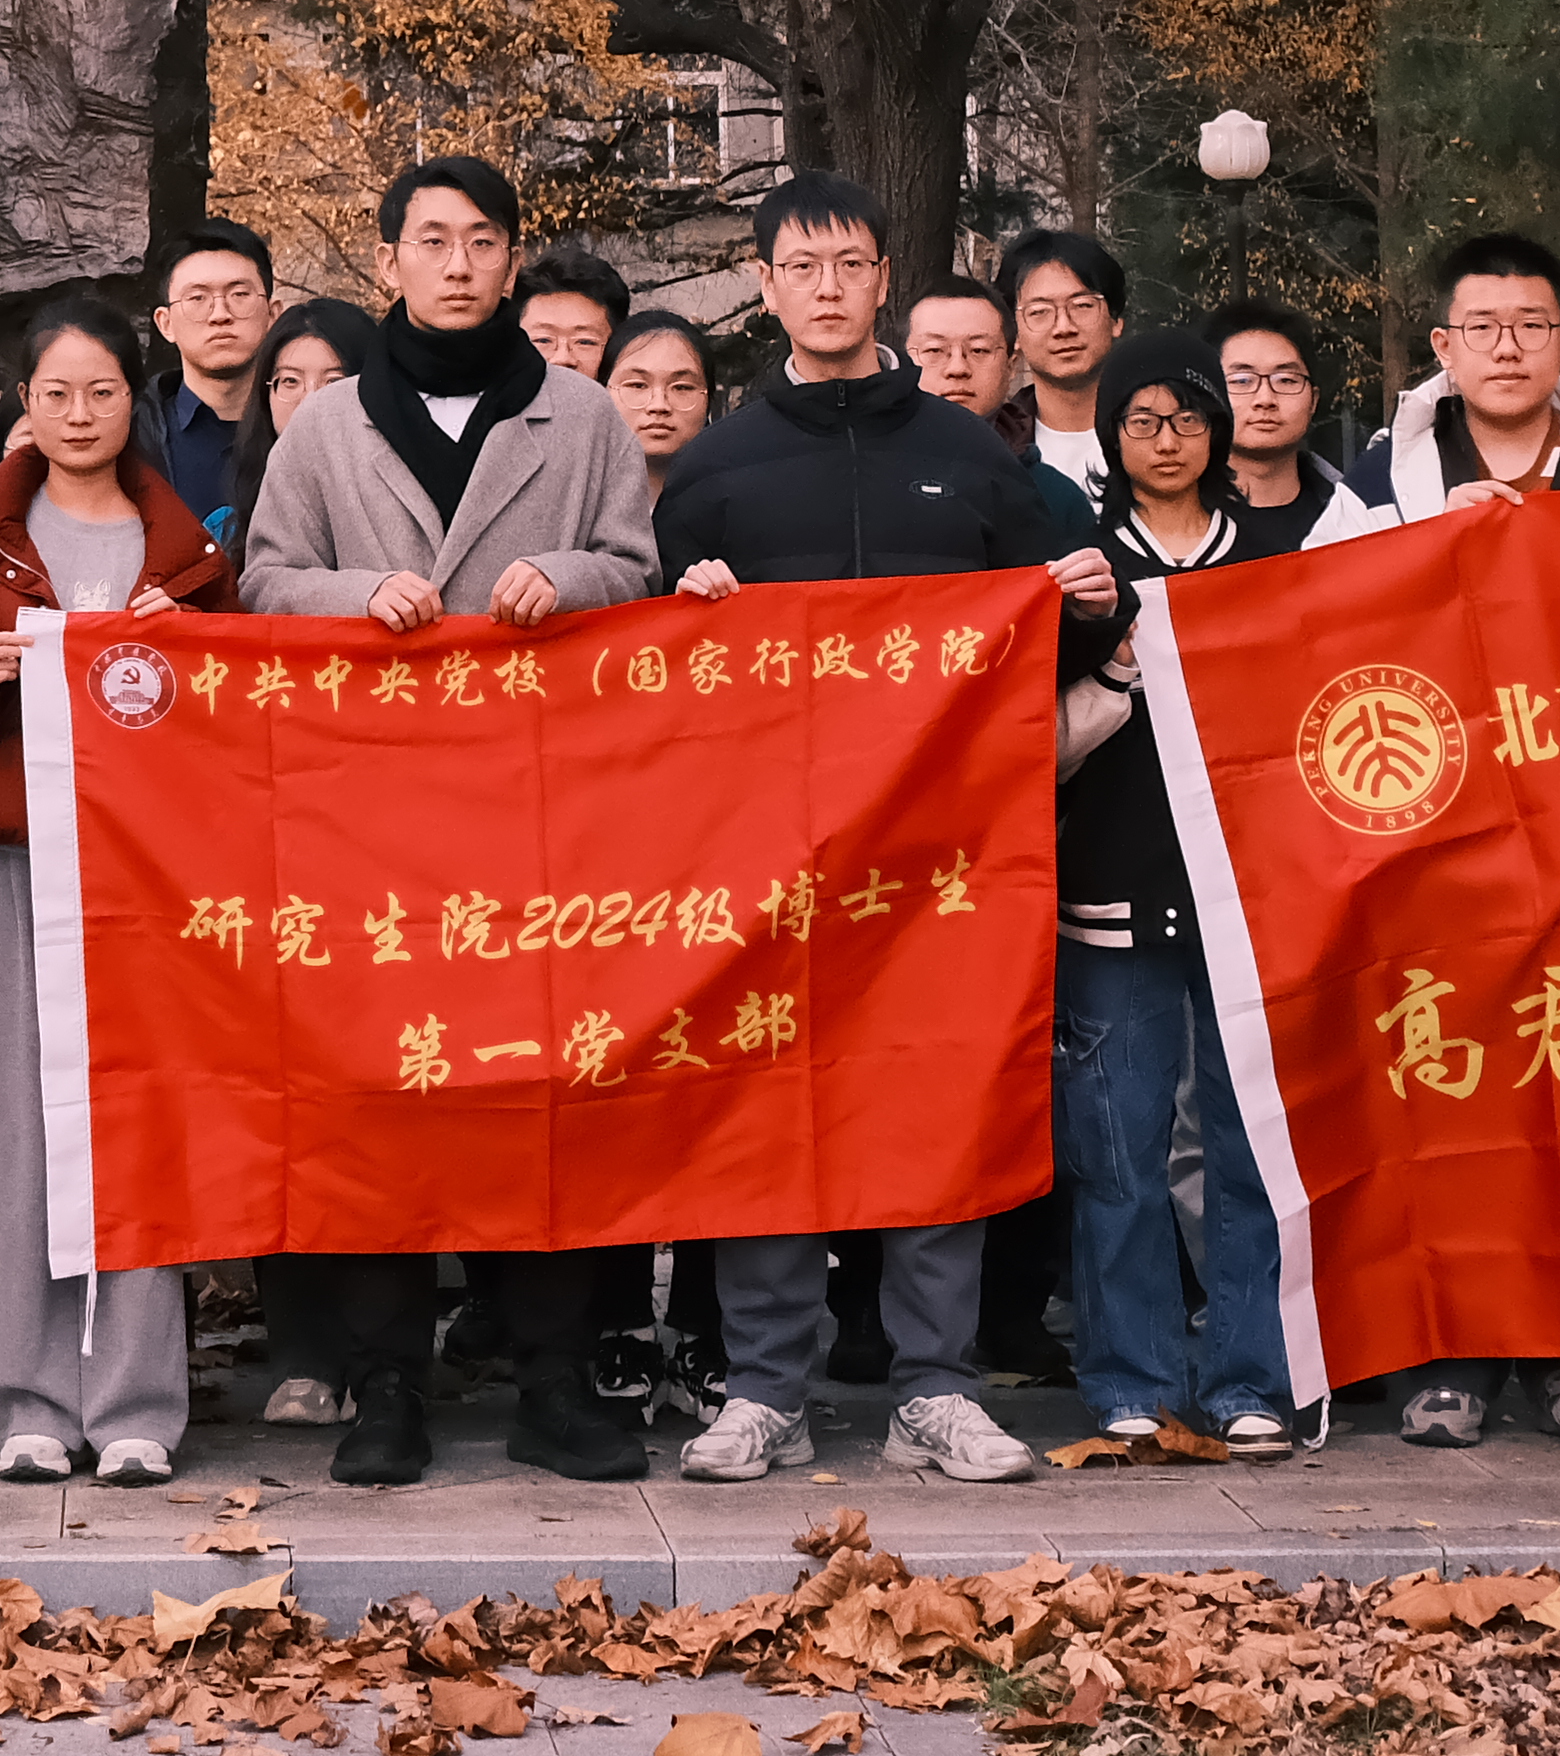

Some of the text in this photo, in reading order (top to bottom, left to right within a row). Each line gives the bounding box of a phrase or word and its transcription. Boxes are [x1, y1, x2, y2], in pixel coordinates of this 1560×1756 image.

[1302, 670, 1462, 799] PEKING UNIVERSITY
[1365, 800, 1435, 829] 1898
[179, 848, 977, 971] 研究生院2024级博士生
[397, 991, 797, 1094] 第一党支部
